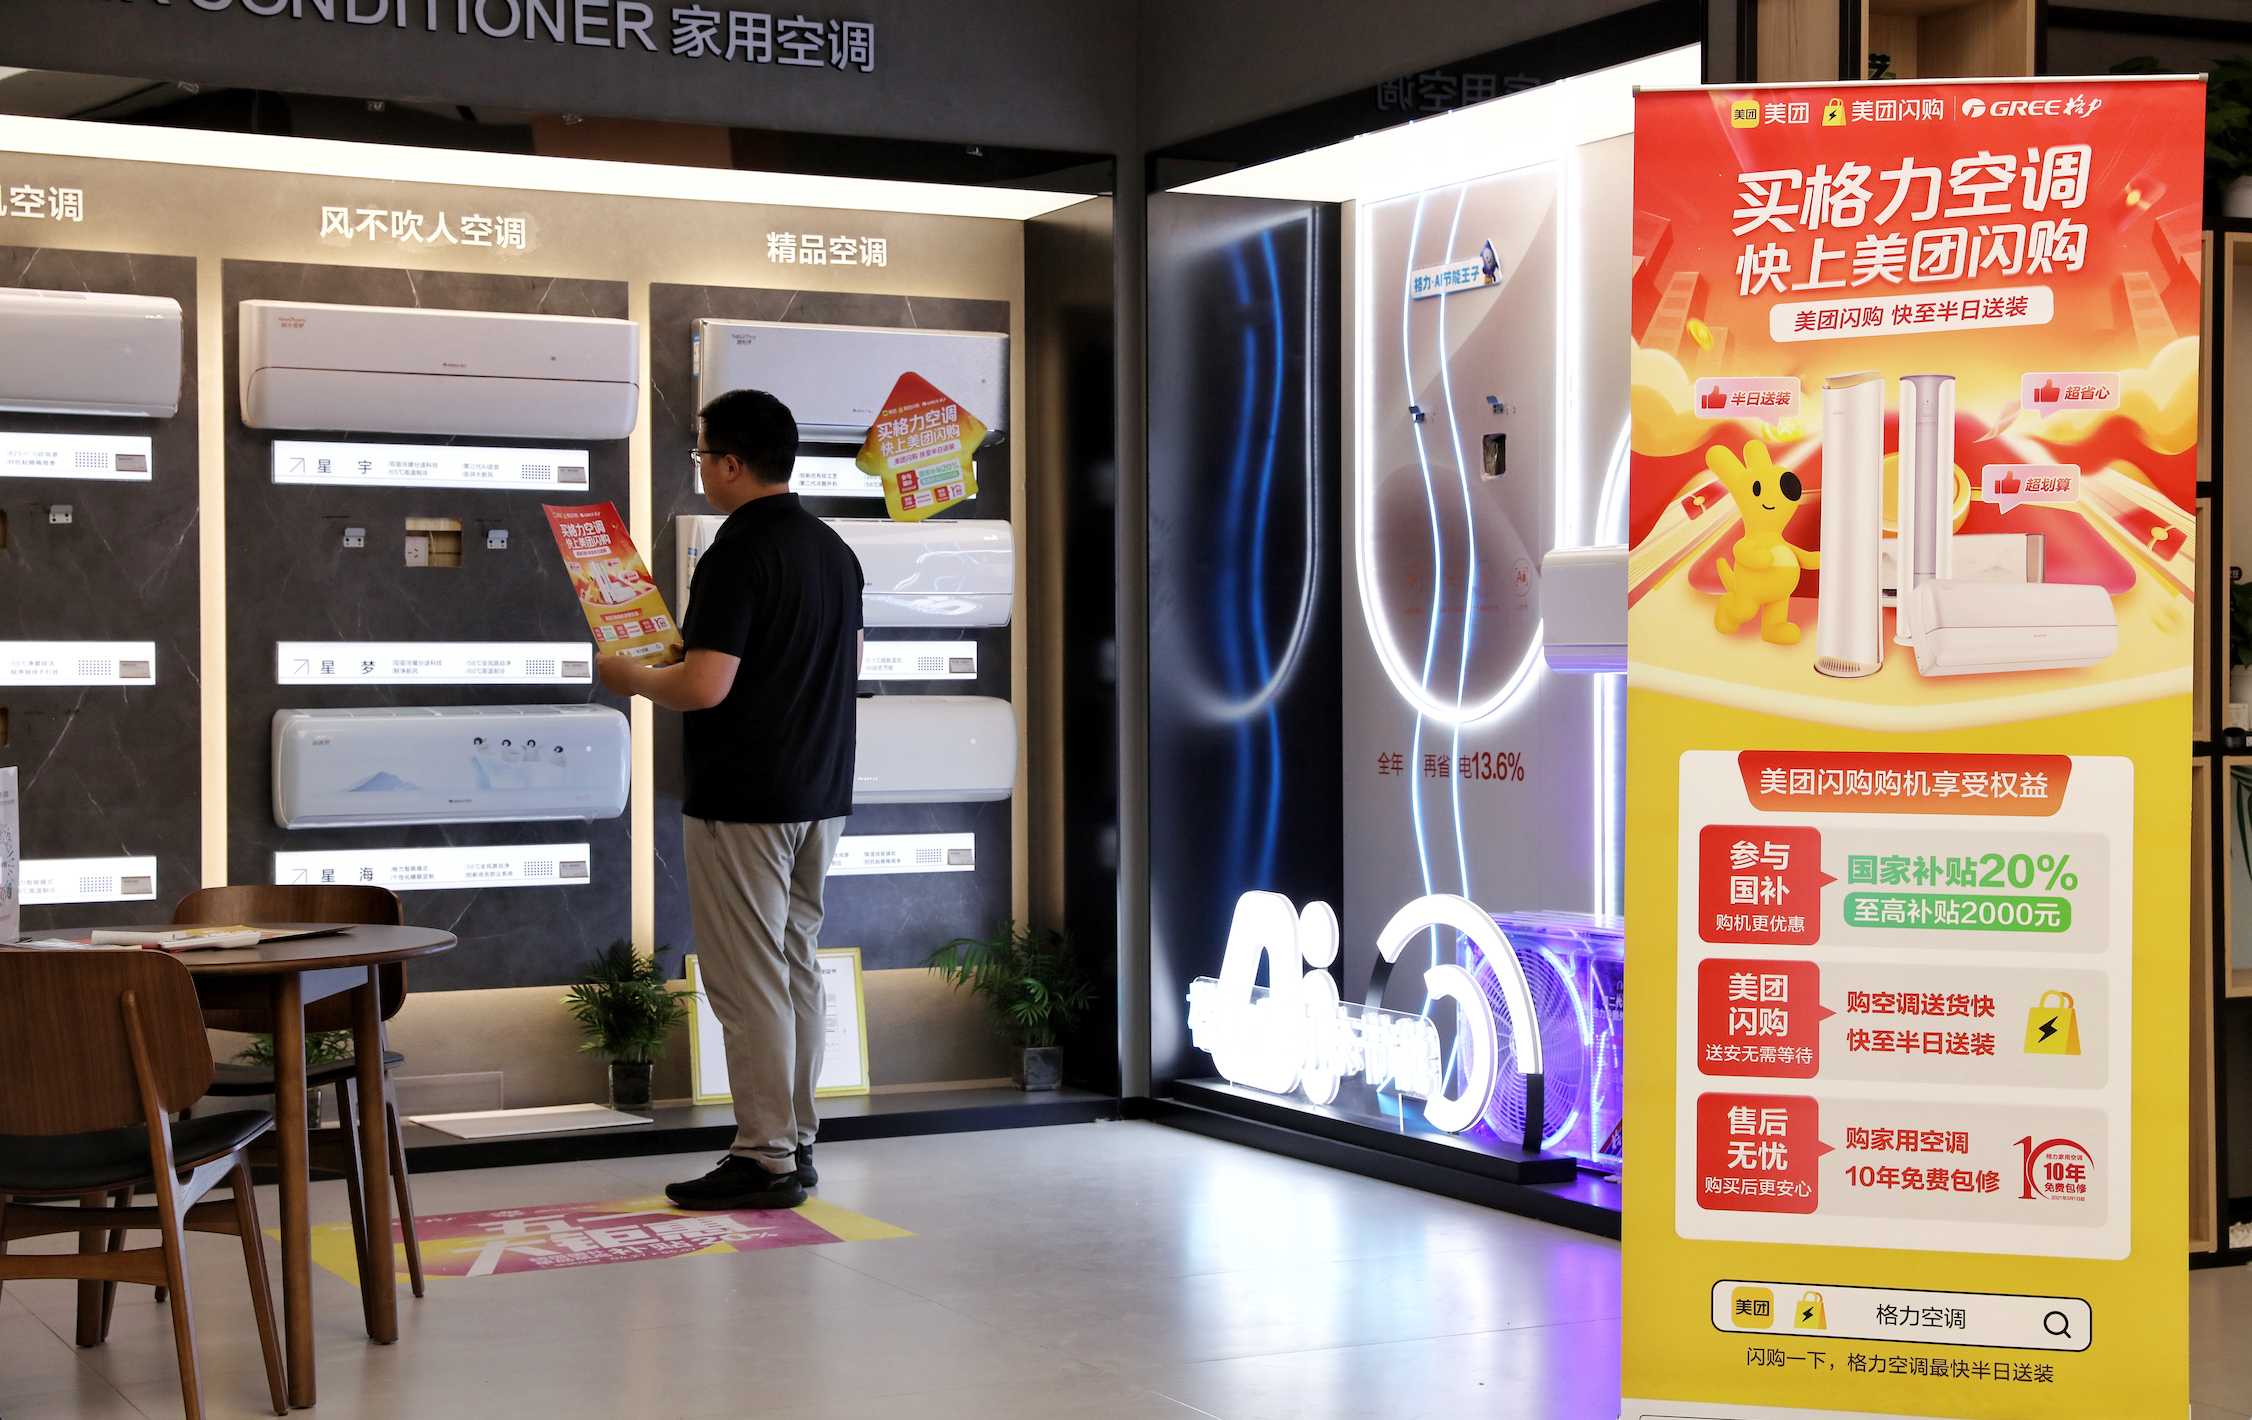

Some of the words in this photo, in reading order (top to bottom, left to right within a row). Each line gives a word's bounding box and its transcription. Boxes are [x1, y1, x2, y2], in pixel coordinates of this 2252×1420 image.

[188, 0, 659, 51] ITIONER
[671, 4, 876, 74] 家用空调
[1734, 107, 1758, 121] 美团
[1764, 102, 1810, 124] 美团
[1851, 99, 1945, 123] 美团闪购
[1990, 100, 2062, 117] GREE
[1732, 143, 2093, 237] 买格力空调
[320, 205, 528, 251] 风不吹人空调
[767, 231, 889, 268] 精品空调
[1735, 217, 2089, 297] 快上美团闪购
[1414, 265, 1480, 293] 格力·AI节能王子
[1793, 306, 1884, 333] 美团闪购
[1891, 295, 2029, 327] 快至半日送装
[1730, 390, 1793, 408] 半日送装
[2064, 384, 2111, 402] 超省心
[876, 404, 958, 442] 买格力空调
[880, 424, 961, 457] 快上美团闪购
[2025, 476, 2072, 494] 超划算
[559, 520, 606, 537] 买格力空调
[565, 534, 611, 549] 快上美团闪购
[1377, 751, 1404, 777] 全年
[1423, 753, 1451, 779] 再省
[1459, 751, 1525, 782] 电13.6%
[1759, 767, 2049, 799] 美团闪购购机享受权益
[1730, 840, 1791, 871] 参与
[1848, 853, 2079, 891] 国家补贴20%
[1730, 875, 1791, 906] 国补
[1715, 913, 1806, 933] 购机更优惠
[1854, 897, 2061, 928] 至高补贴2000元
[1728, 972, 1789, 1003] 美团
[1847, 991, 1996, 1018] 购空调送货快
[1728, 1007, 1789, 1037] 闪购
[1705, 1044, 1813, 1066] 送安无需等待
[1846, 1028, 1996, 1057] 快至半日送装
[1727, 1105, 1789, 1137] 售后
[1846, 1127, 1969, 1154] 购家用空调
[1727, 1140, 1789, 1172] 无忧
[2046, 1153, 2083, 1161] 格力家用空调
[1704, 1176, 1812, 1198] 购买后更安心
[1845, 1164, 2001, 1195] 10年免费包修
[2043, 1162, 2086, 1183] 10年
[2044, 1182, 2087, 1194] 免费包修
[1735, 1298, 1770, 1319] 美团
[1875, 1304, 1968, 1331] 格力空调
[1746, 1346, 2056, 1385] 闪购一下，格力空调最快半日送装
